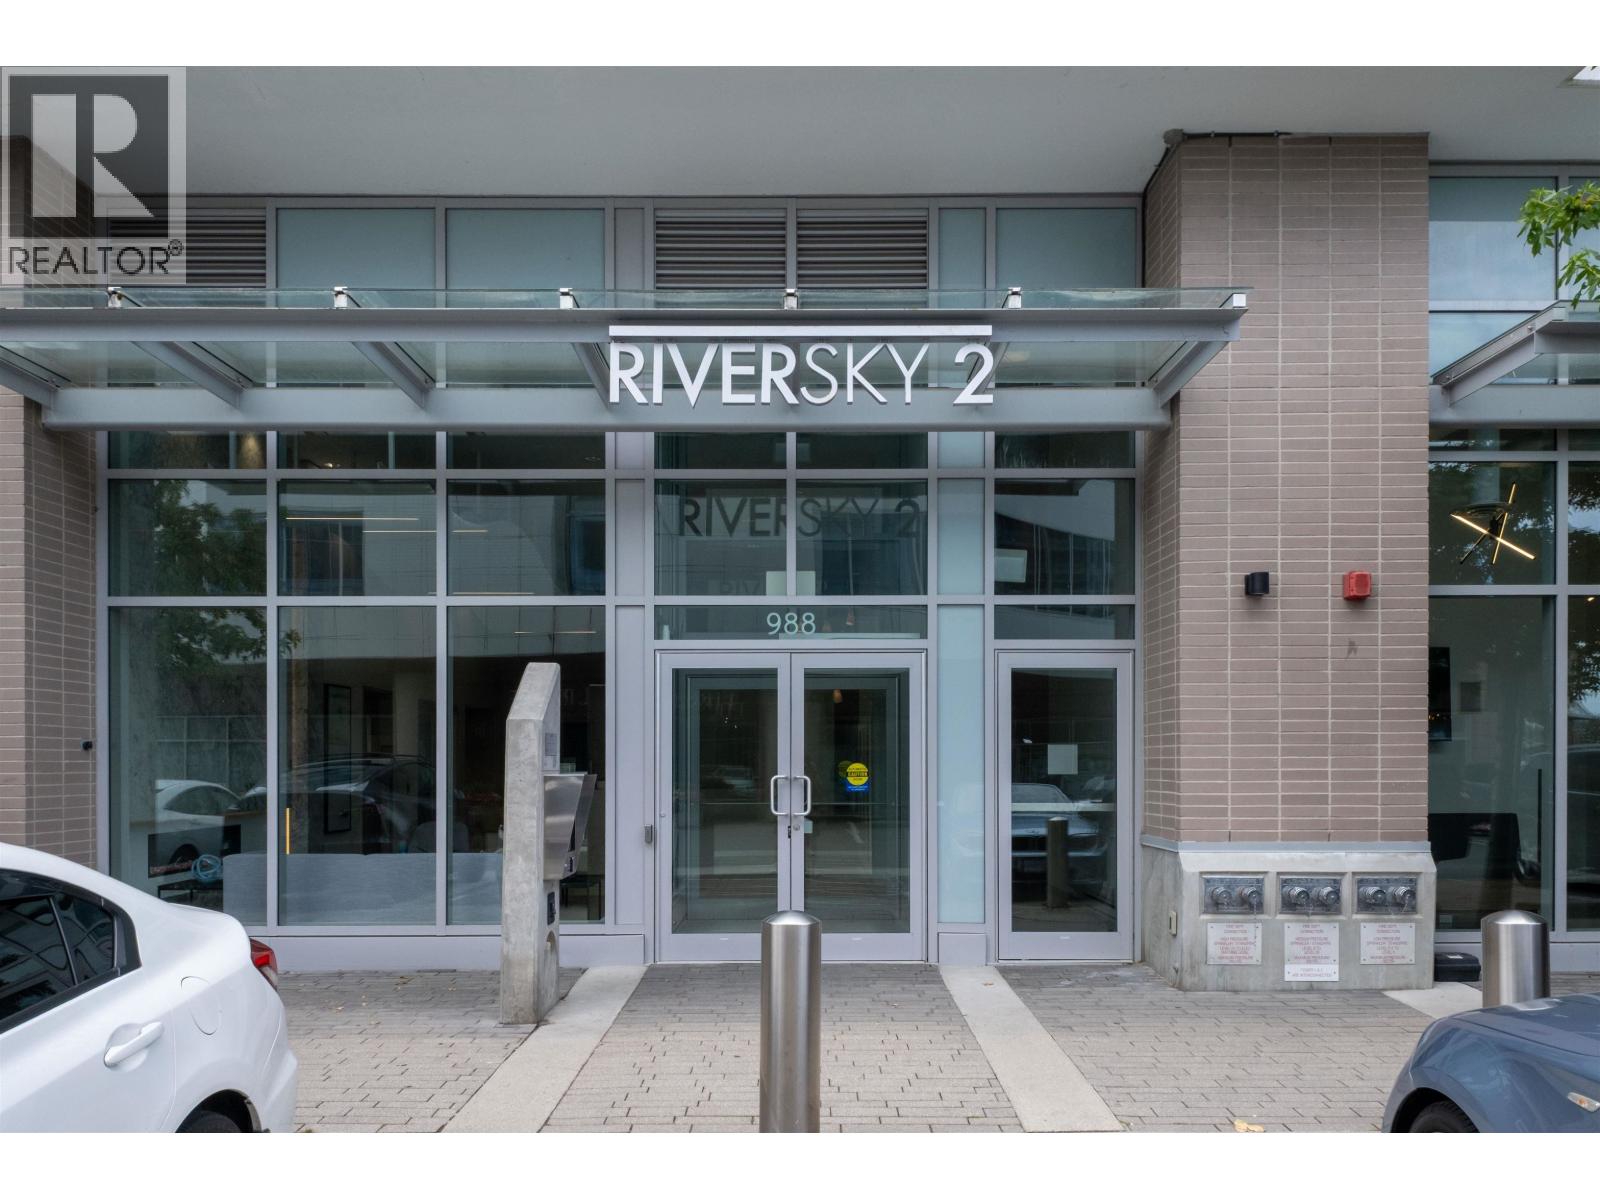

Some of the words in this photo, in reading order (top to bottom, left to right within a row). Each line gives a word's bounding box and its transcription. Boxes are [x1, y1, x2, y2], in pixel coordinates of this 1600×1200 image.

[609, 342, 930, 408] RIVERSKY
[952, 342, 994, 405] 2
[895, 496, 920, 538] 2
[766, 612, 816, 635] 988
